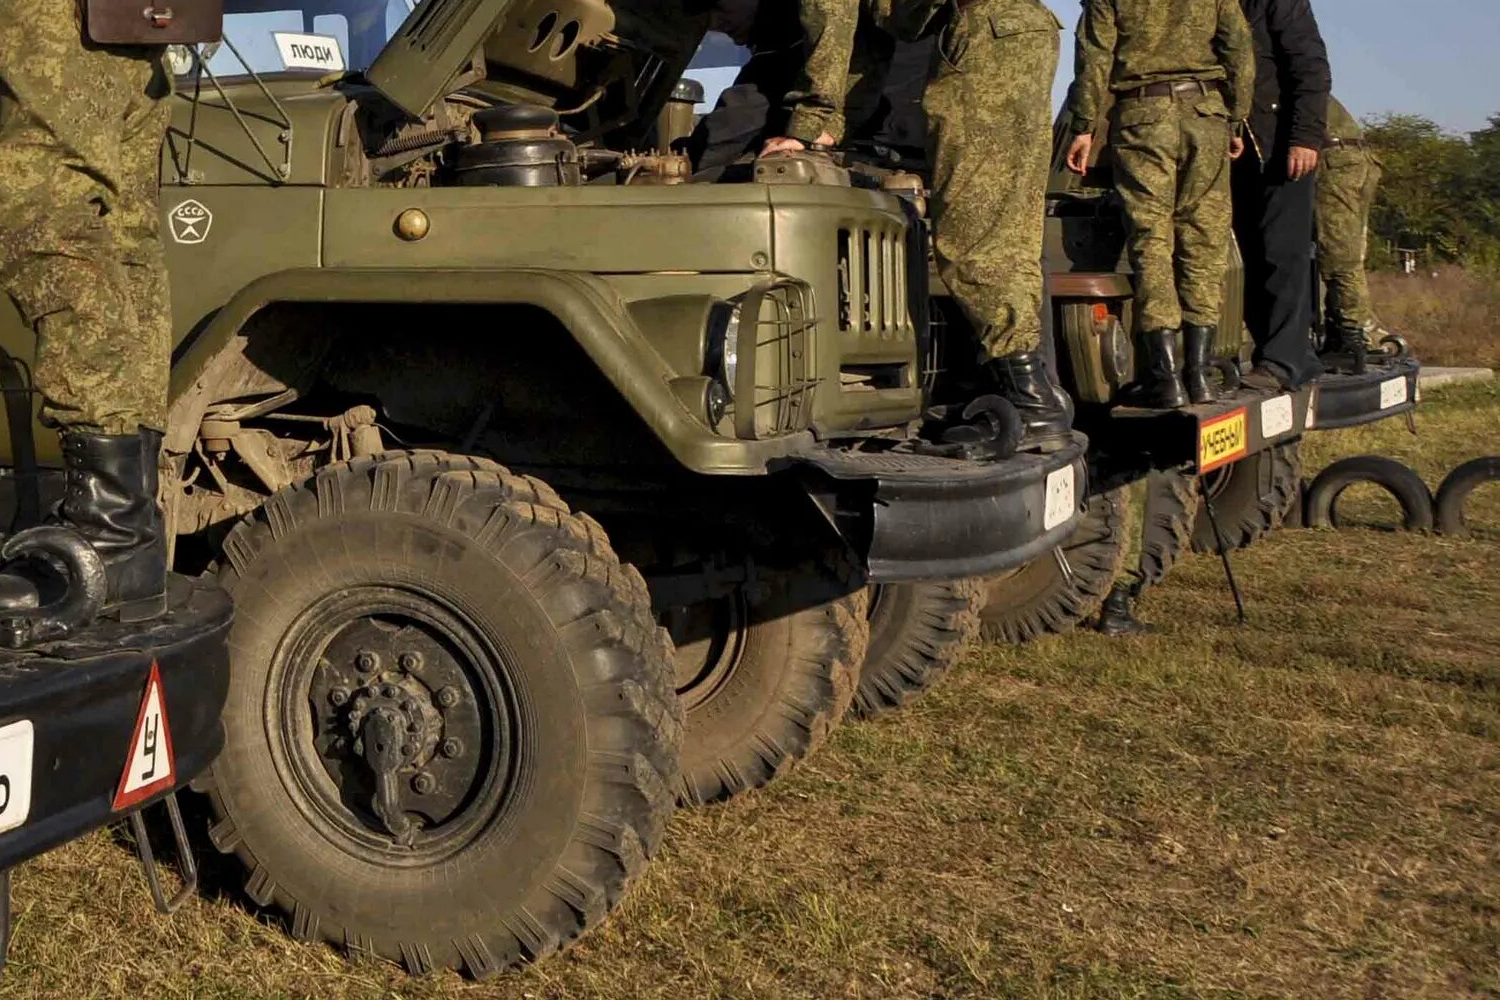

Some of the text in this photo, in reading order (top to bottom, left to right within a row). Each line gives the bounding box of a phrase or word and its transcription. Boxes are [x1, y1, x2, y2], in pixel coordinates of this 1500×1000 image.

[291, 44, 334, 63] ЛЮДИ
[177, 206, 205, 217] СССР
[141, 713, 159, 781] У
